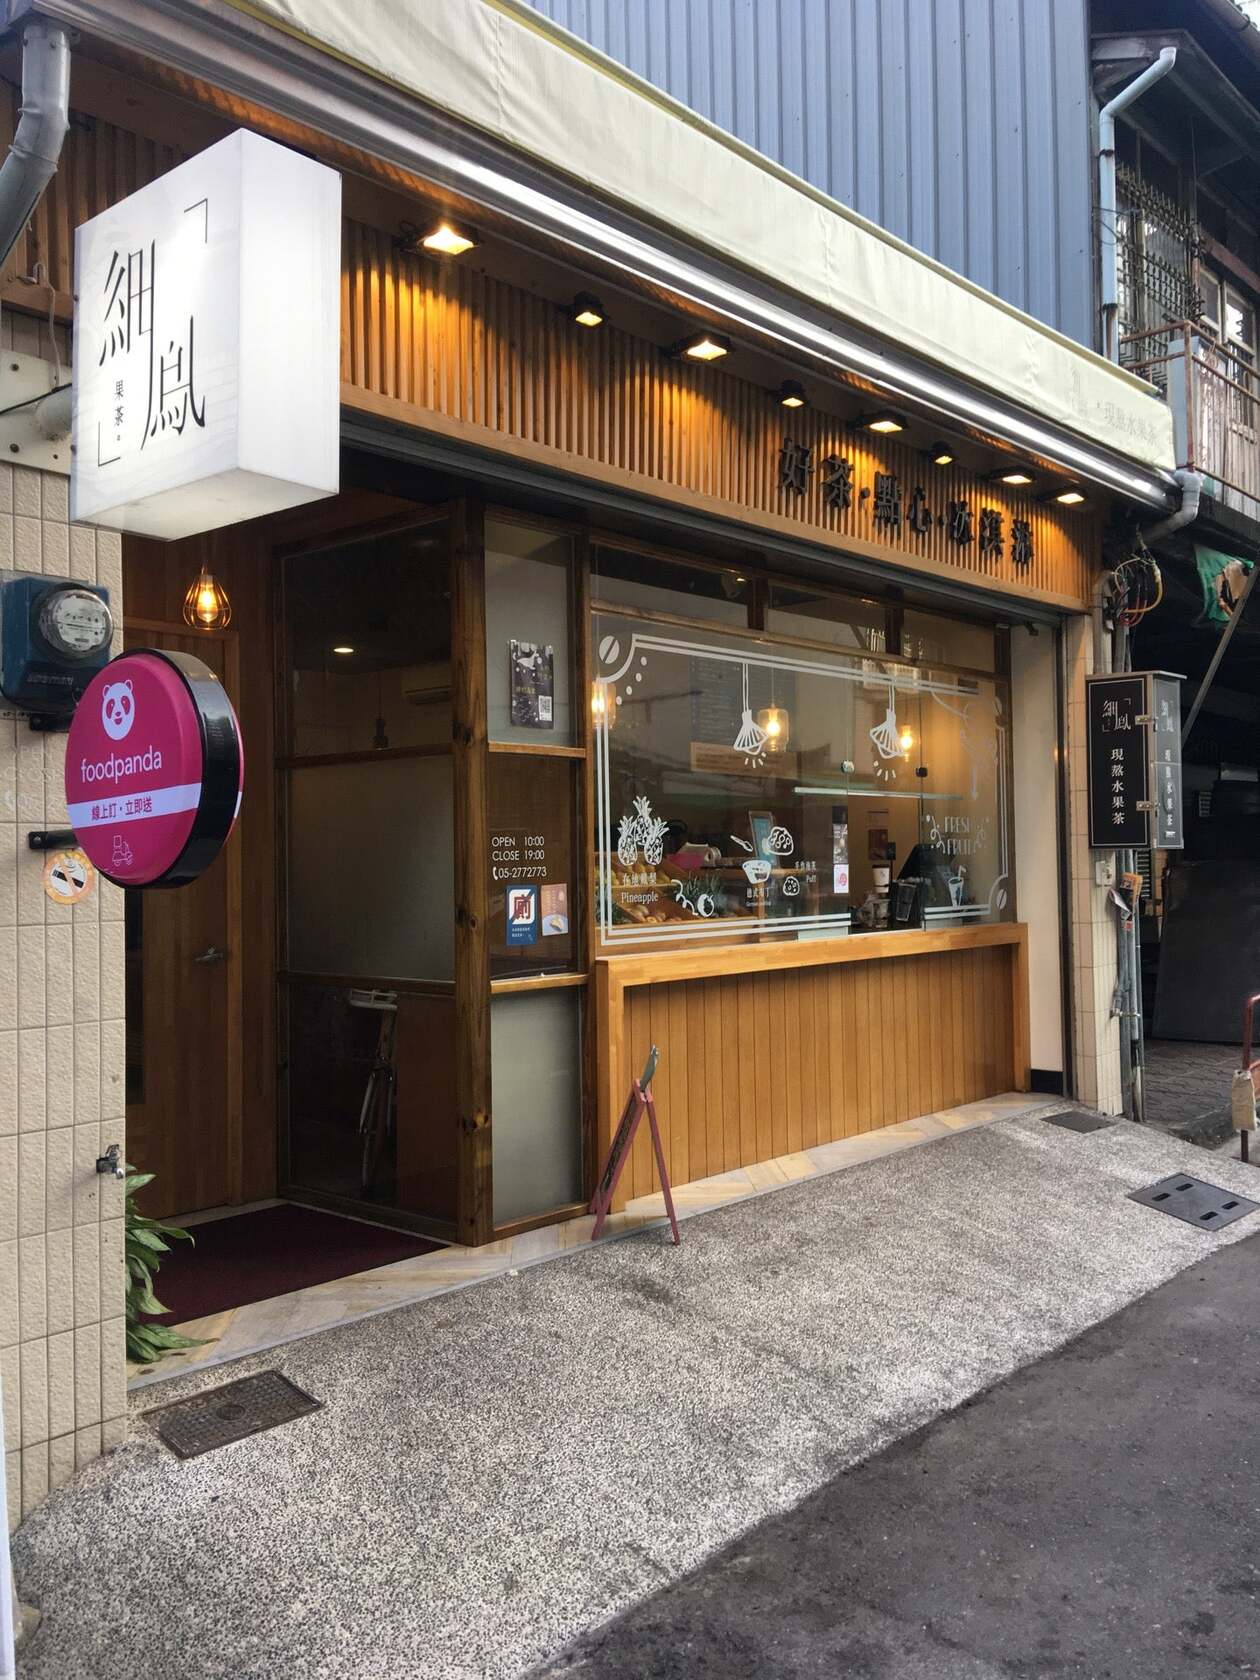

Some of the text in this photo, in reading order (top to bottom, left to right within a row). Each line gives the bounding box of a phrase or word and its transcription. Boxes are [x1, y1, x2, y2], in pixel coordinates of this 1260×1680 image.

[80, 744, 163, 785] foodpanda
[491, 836, 545, 847] OPEN 10:00
[492, 850, 545, 861] CLOSE 19:00
[498, 866, 547, 879] 05-2772773
[620, 890, 659, 906] Pineapple
